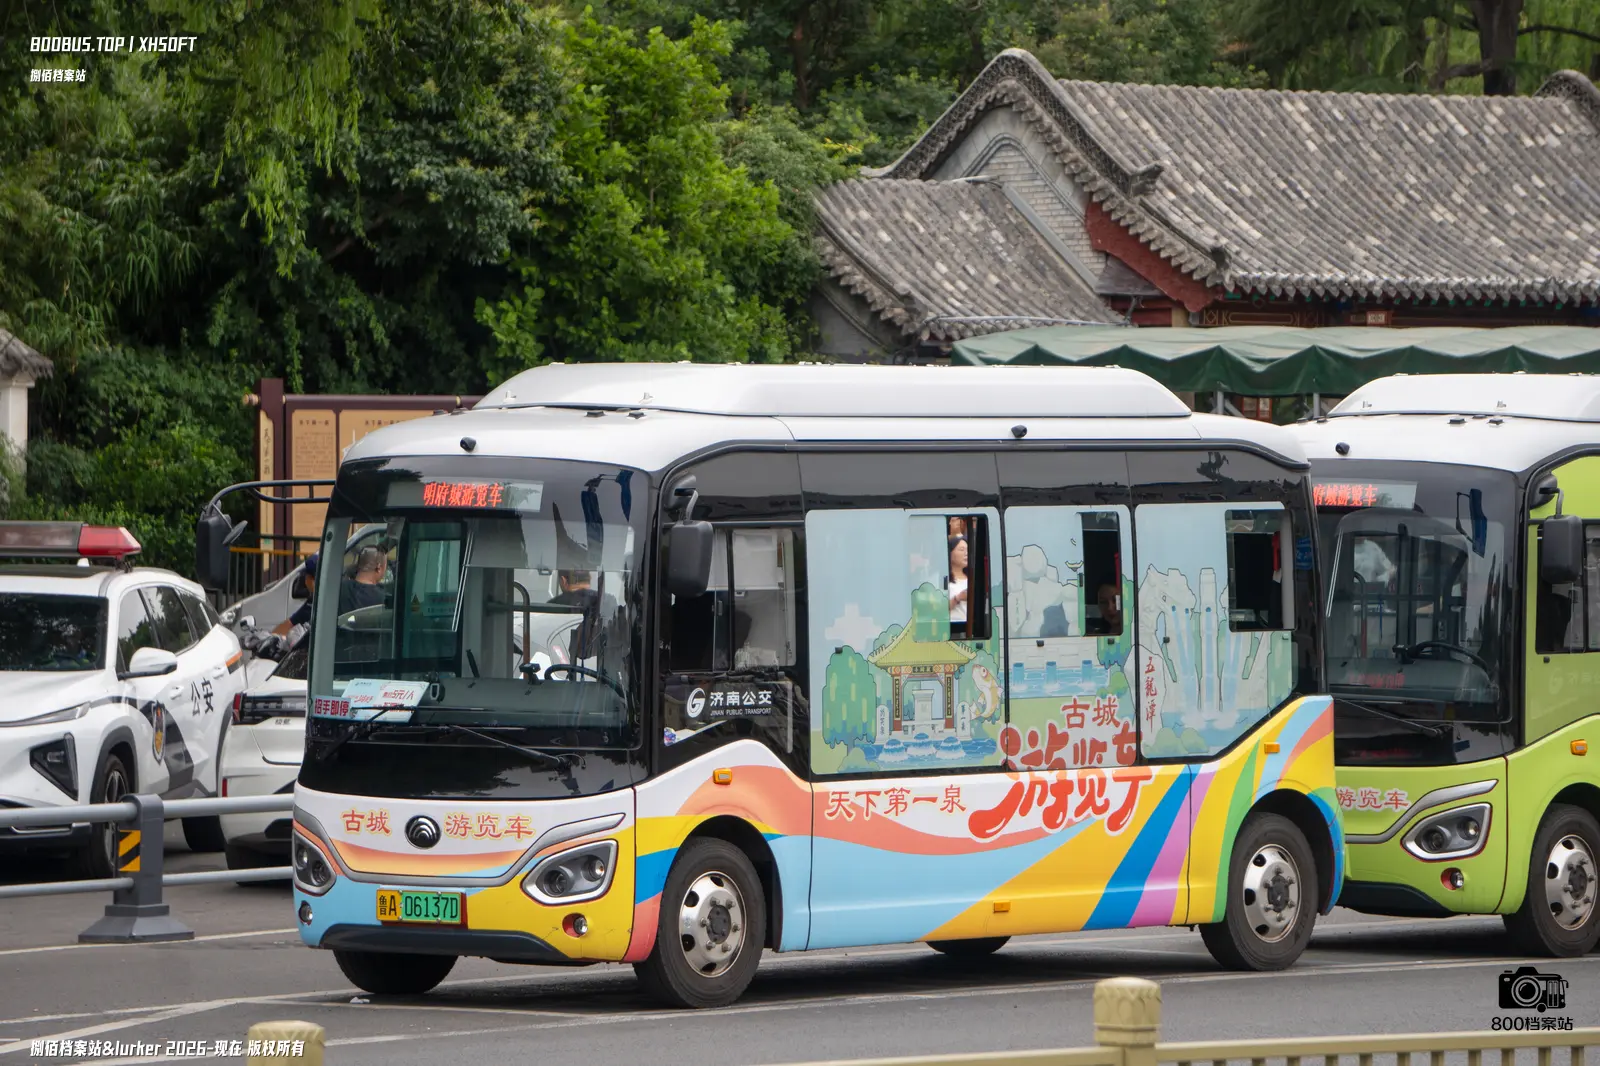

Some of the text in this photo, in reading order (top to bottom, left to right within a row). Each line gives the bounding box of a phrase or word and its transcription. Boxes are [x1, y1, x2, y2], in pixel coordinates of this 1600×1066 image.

[423, 482, 504, 508] 明府城游览车
[190, 677, 214, 717] 公安
[314, 698, 350, 716] 招手即停
[710, 690, 772, 707] 济南公交
[1062, 698, 1120, 728] 古城
[968, 722, 1152, 841] 游览车
[826, 784, 967, 818] 天下第一泉
[1337, 787, 1409, 810] 游览车
[342, 808, 534, 841] 古城 游览车
[404, 895, 459, 918] 06137D
